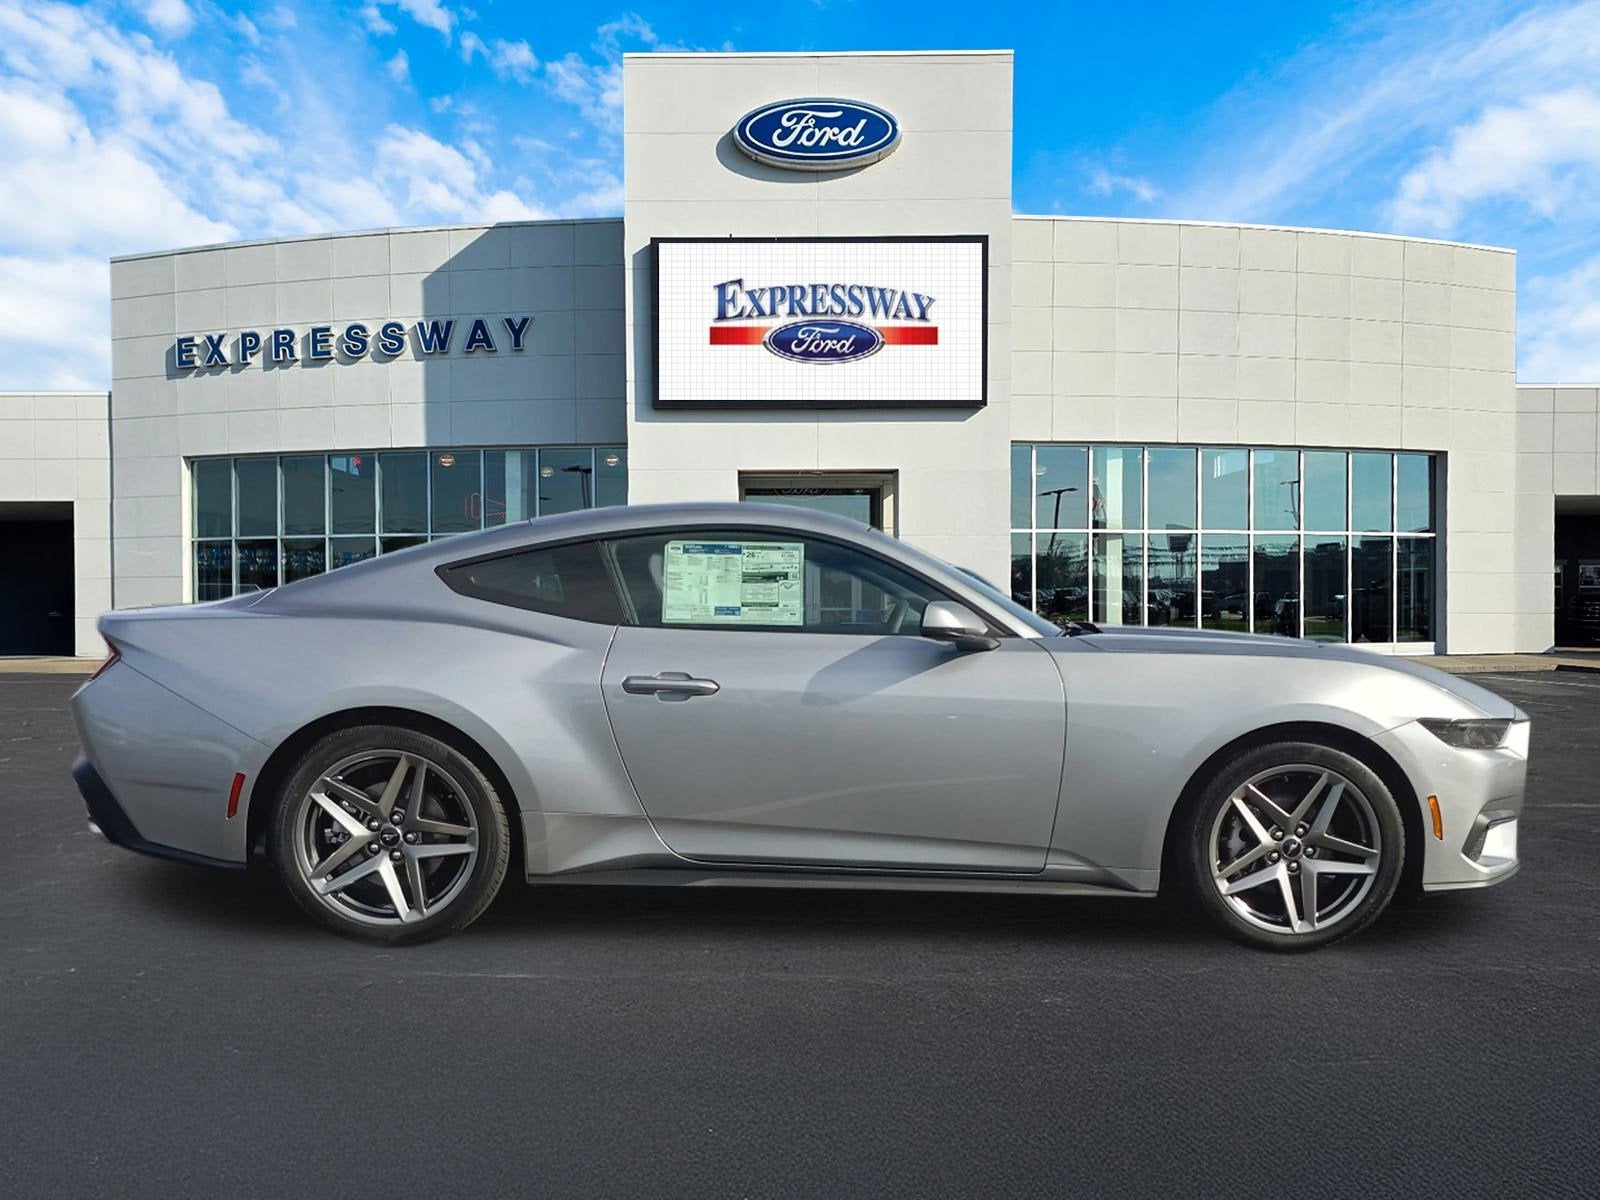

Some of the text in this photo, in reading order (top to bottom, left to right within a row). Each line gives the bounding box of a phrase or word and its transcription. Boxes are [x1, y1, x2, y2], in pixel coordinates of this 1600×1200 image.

[771, 109, 867, 148] Ford
[713, 277, 937, 323] EXPRESSWAY
[175, 315, 533, 368] EXPRESSWAY
[791, 326, 856, 355] Ford
